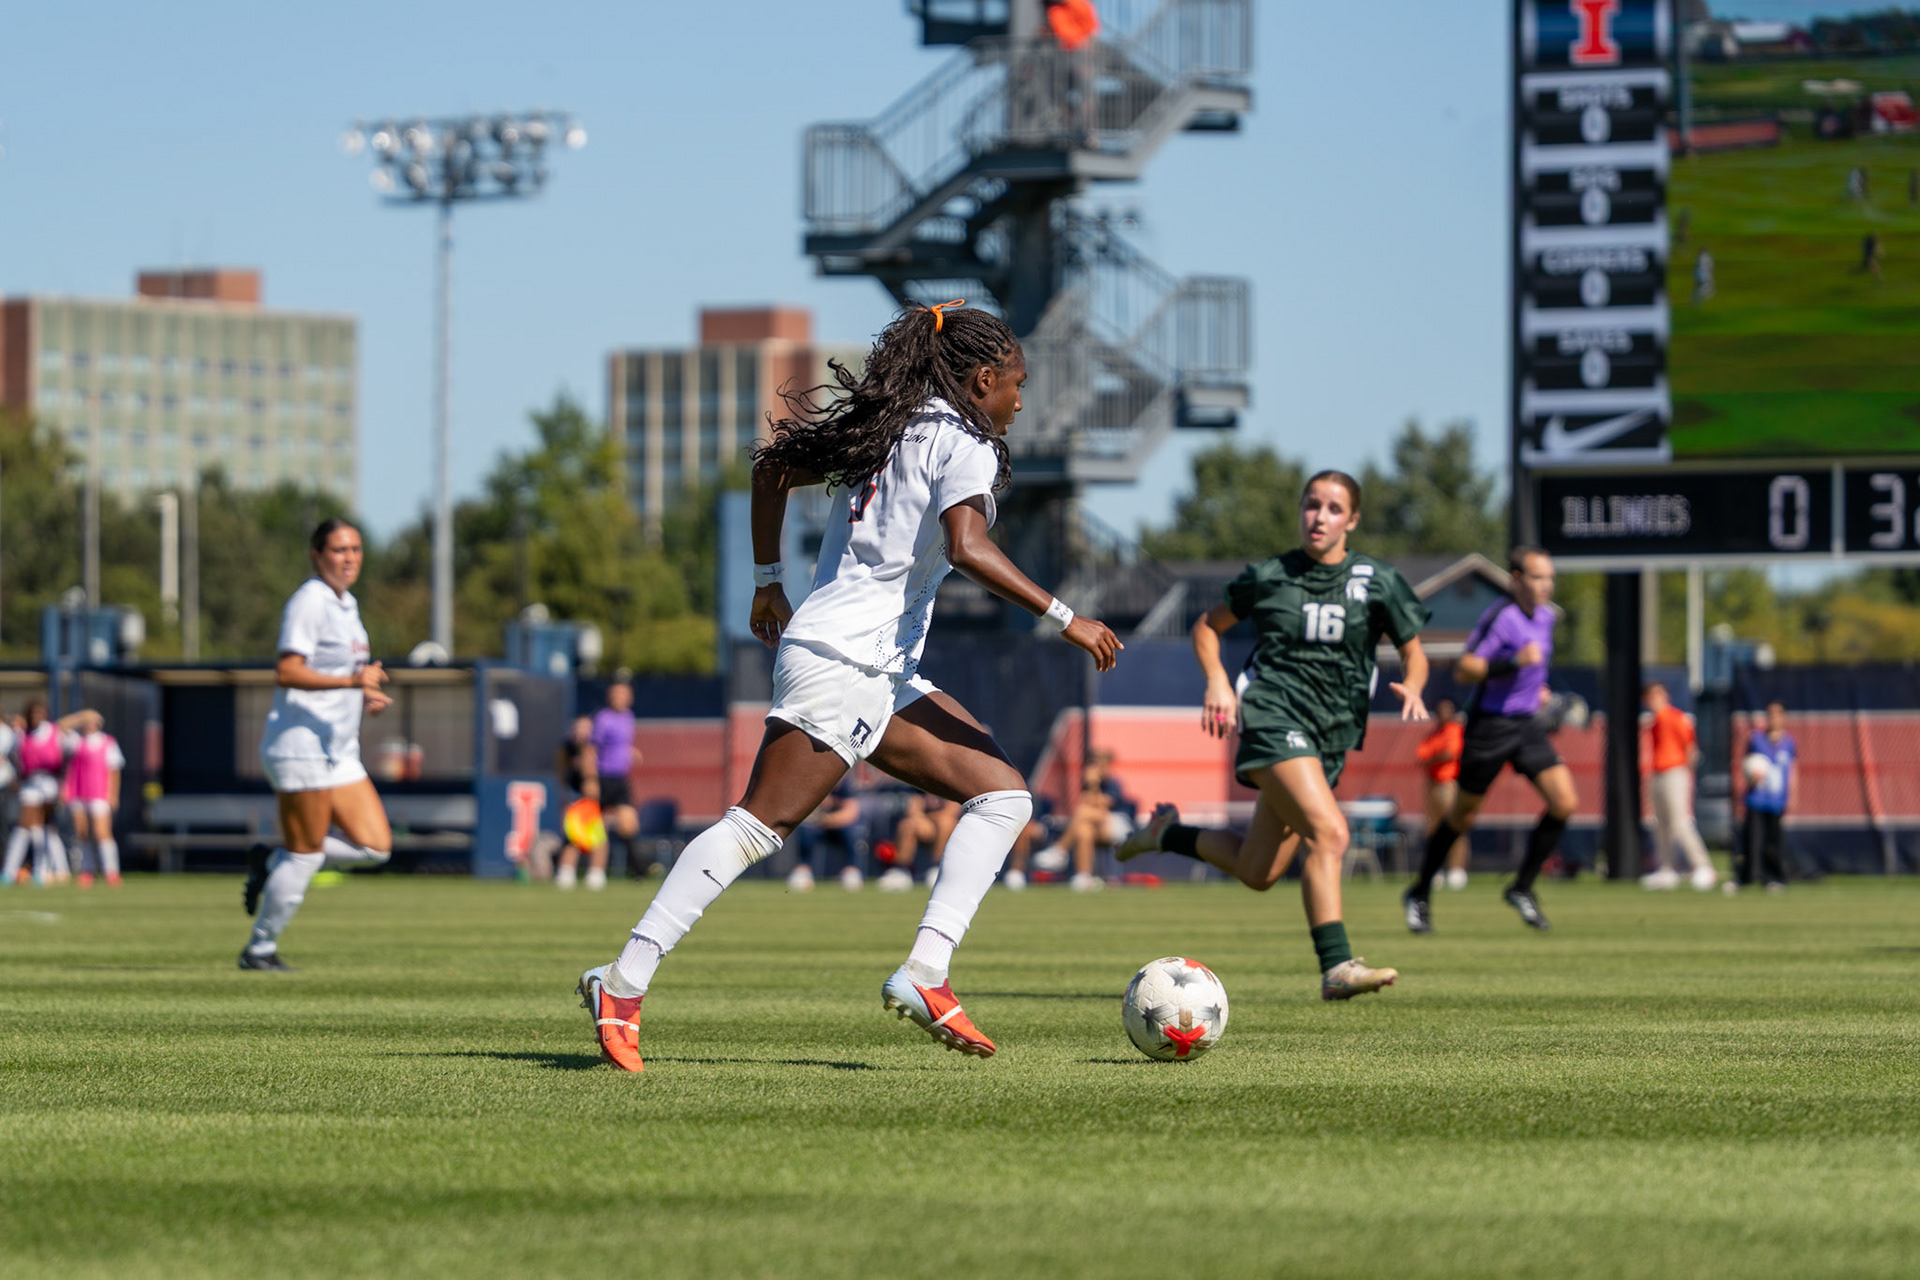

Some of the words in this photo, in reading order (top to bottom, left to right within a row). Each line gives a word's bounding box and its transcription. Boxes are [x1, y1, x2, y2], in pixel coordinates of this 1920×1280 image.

[1580, 106, 1611, 143] 0
[1580, 187, 1611, 225] 0
[1580, 268, 1611, 308] 0
[1580, 349, 1611, 388] 0
[1768, 475, 1810, 551] 0
[1869, 473, 1920, 550] 3
[1302, 602, 1346, 643] 16
